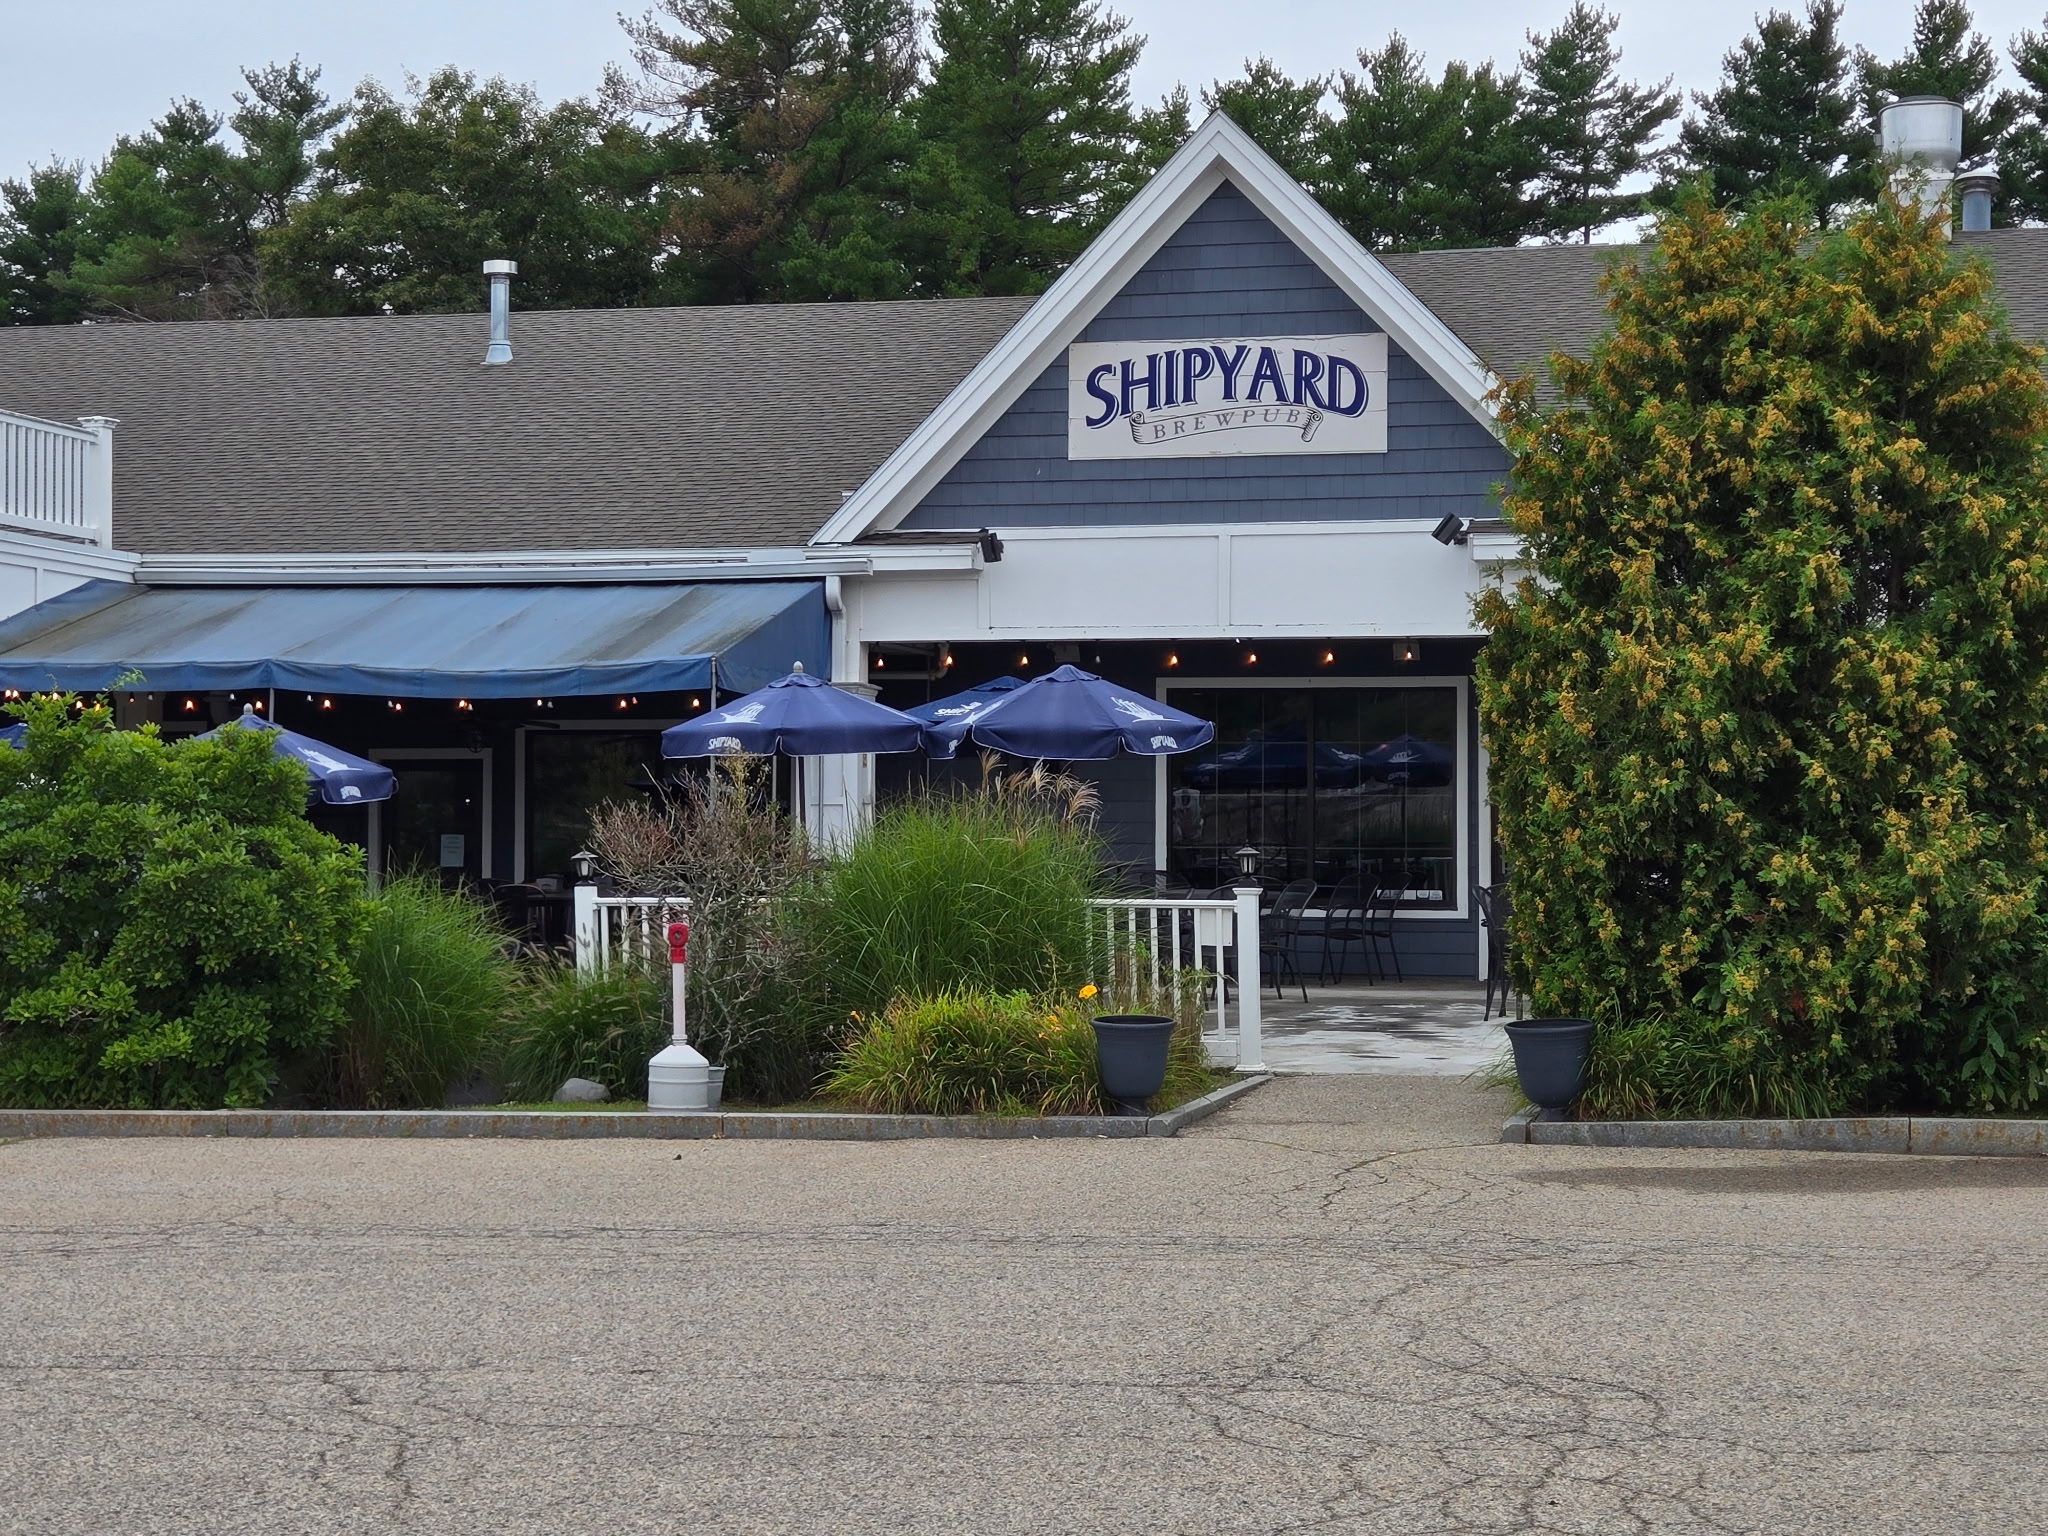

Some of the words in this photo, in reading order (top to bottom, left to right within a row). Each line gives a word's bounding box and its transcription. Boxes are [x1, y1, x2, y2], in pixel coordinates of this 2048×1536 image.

[1086, 345, 1369, 430] SHIPYARD
[1153, 408, 1301, 440] BREWPUB
[708, 736, 742, 750] SHIPYARD
